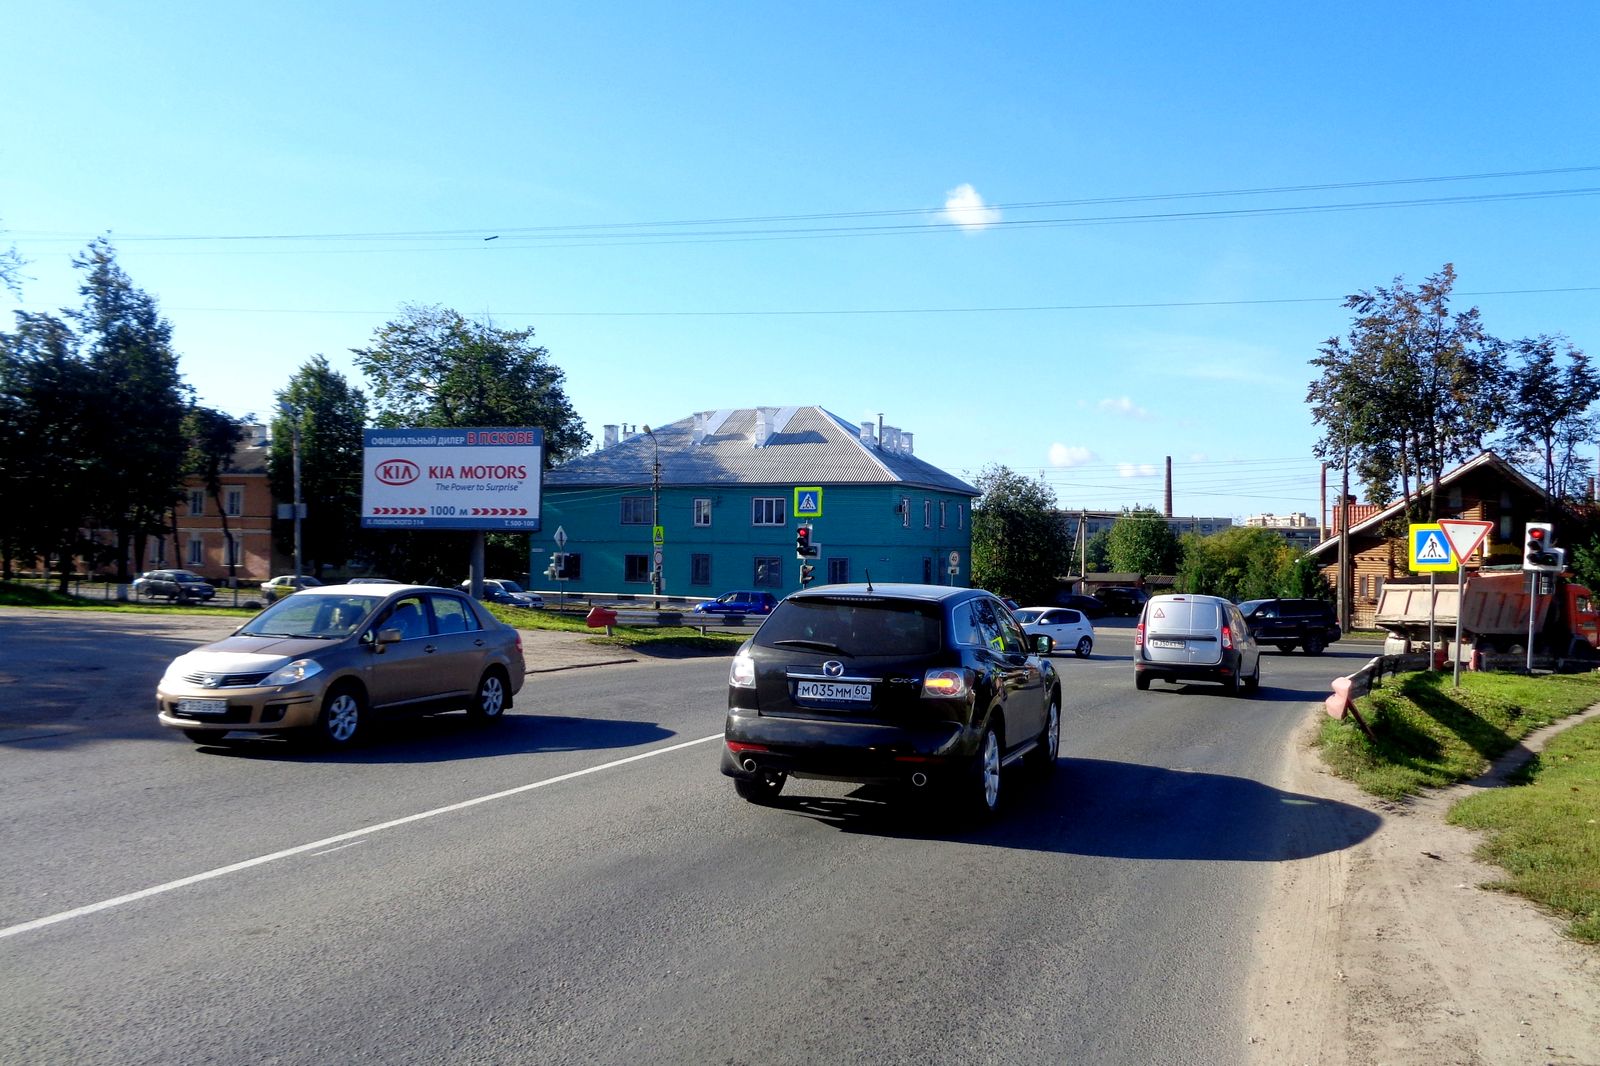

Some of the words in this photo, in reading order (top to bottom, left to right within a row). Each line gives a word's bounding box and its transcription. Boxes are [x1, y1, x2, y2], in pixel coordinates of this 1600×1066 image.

[371, 435, 437, 446] ОФИЦИАЛЬНЫЙ
[438, 437, 465, 446] ДИЛЕР
[467, 432, 477, 445] В
[479, 431, 534, 445] ПСКОВЕ
[383, 466, 413, 479] KIA
[429, 466, 455, 479] KIA
[460, 465, 527, 480] MOTORS
[436, 483, 450, 491] The
[451, 483, 475, 491] Power
[476, 483, 485, 491] to
[430, 506, 456, 516] 1000
[855, 686, 868, 696] 60
